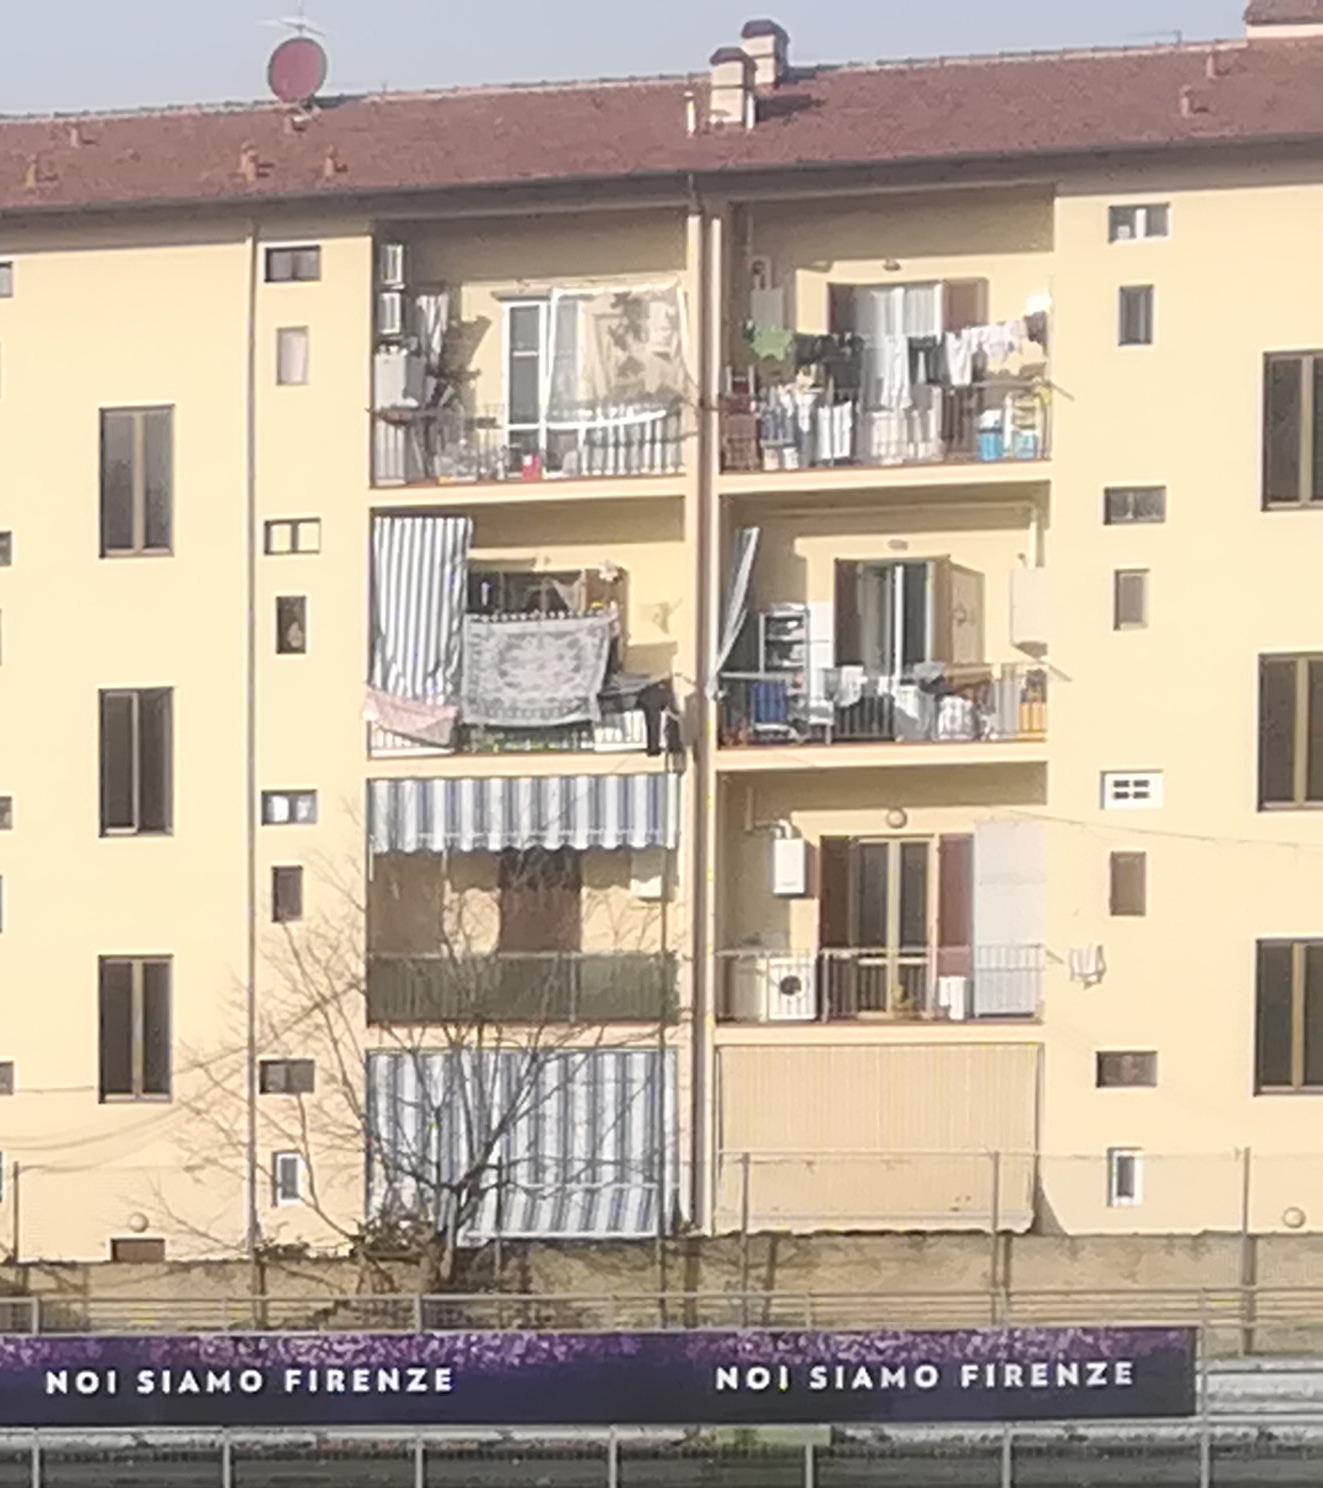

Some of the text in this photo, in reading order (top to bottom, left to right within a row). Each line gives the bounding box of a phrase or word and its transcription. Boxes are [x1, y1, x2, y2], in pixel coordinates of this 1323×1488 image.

[45, 1367, 452, 1395] NOI SIAMO FIRENZE
[715, 1361, 1133, 1390] NOI SIAMO FIRENZE
